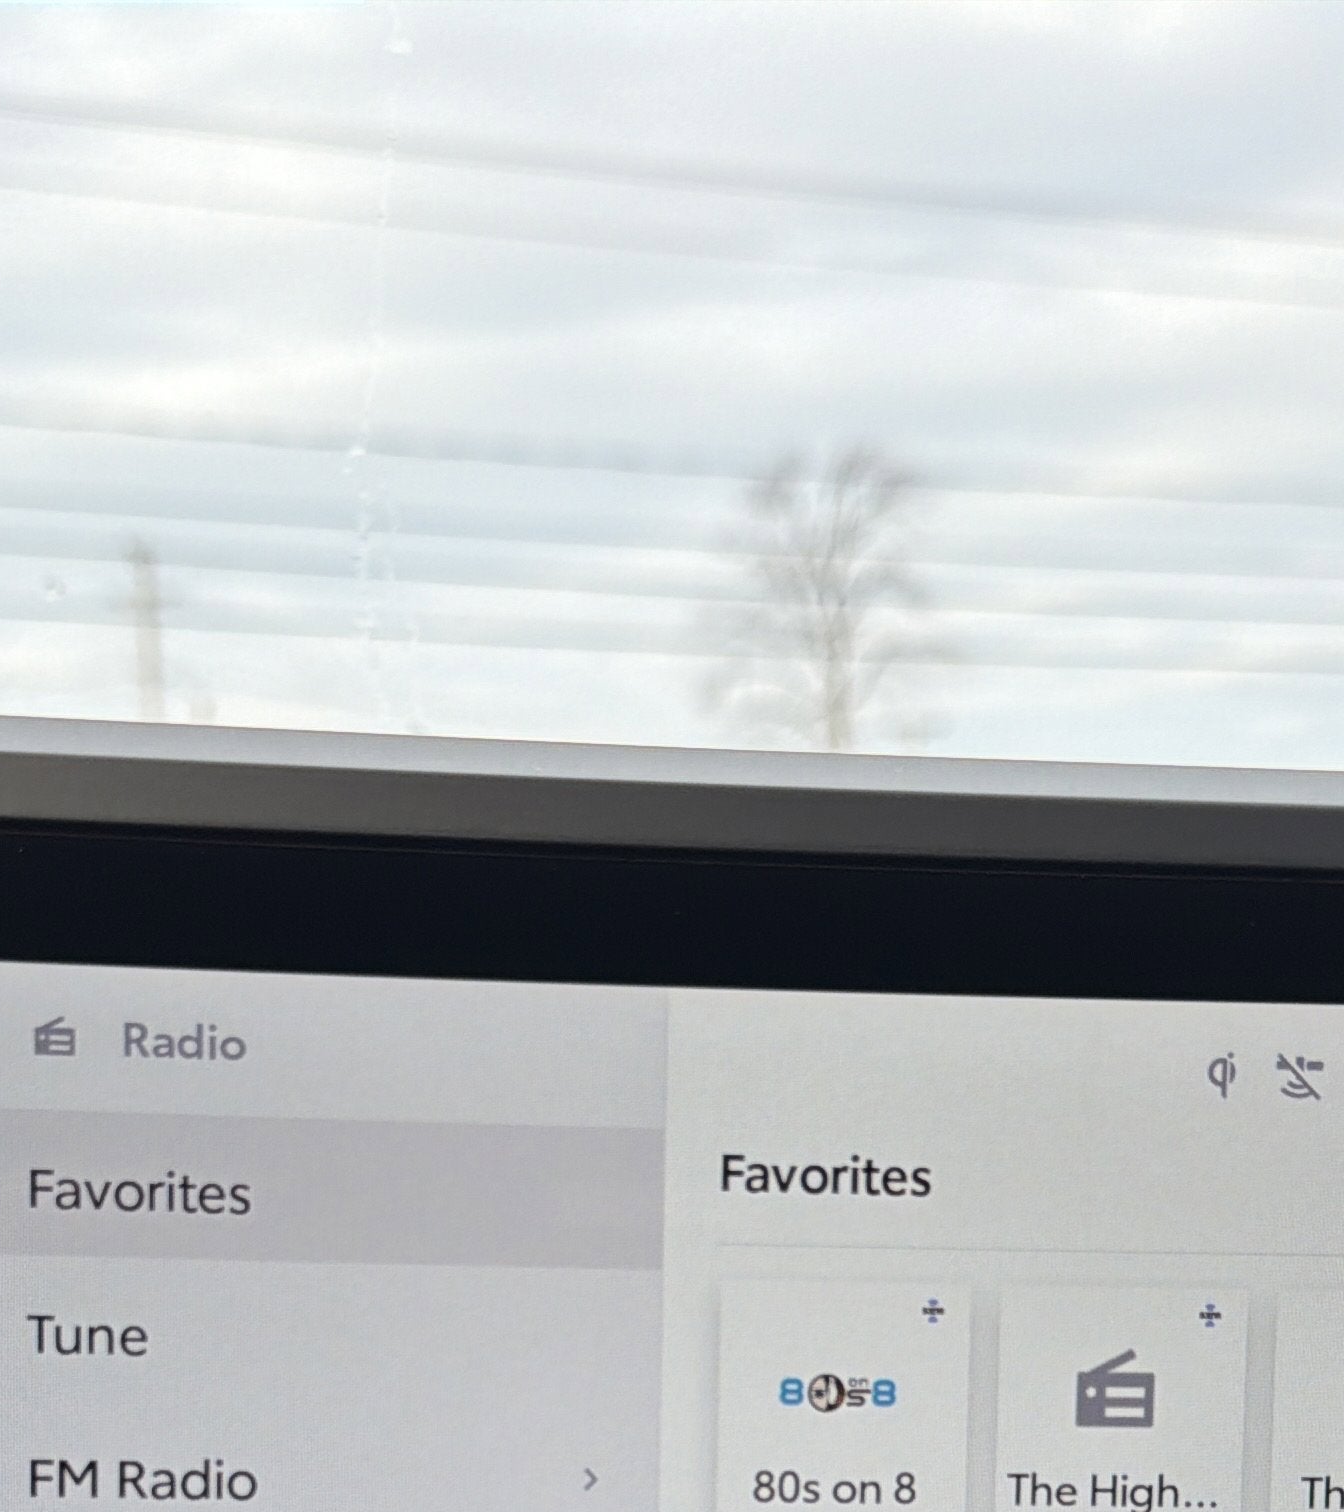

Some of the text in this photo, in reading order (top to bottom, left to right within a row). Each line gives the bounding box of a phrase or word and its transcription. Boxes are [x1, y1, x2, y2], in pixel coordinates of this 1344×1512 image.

[122, 1021, 248, 1062] Radio
[27, 1168, 253, 1217] Favorites
[721, 1153, 933, 1199] Favorites
[27, 1313, 150, 1358] Tune
[27, 1458, 258, 1502] FM Radio
[753, 1469, 917, 1505] 80s on 8
[1007, 1472, 1078, 1511] The
